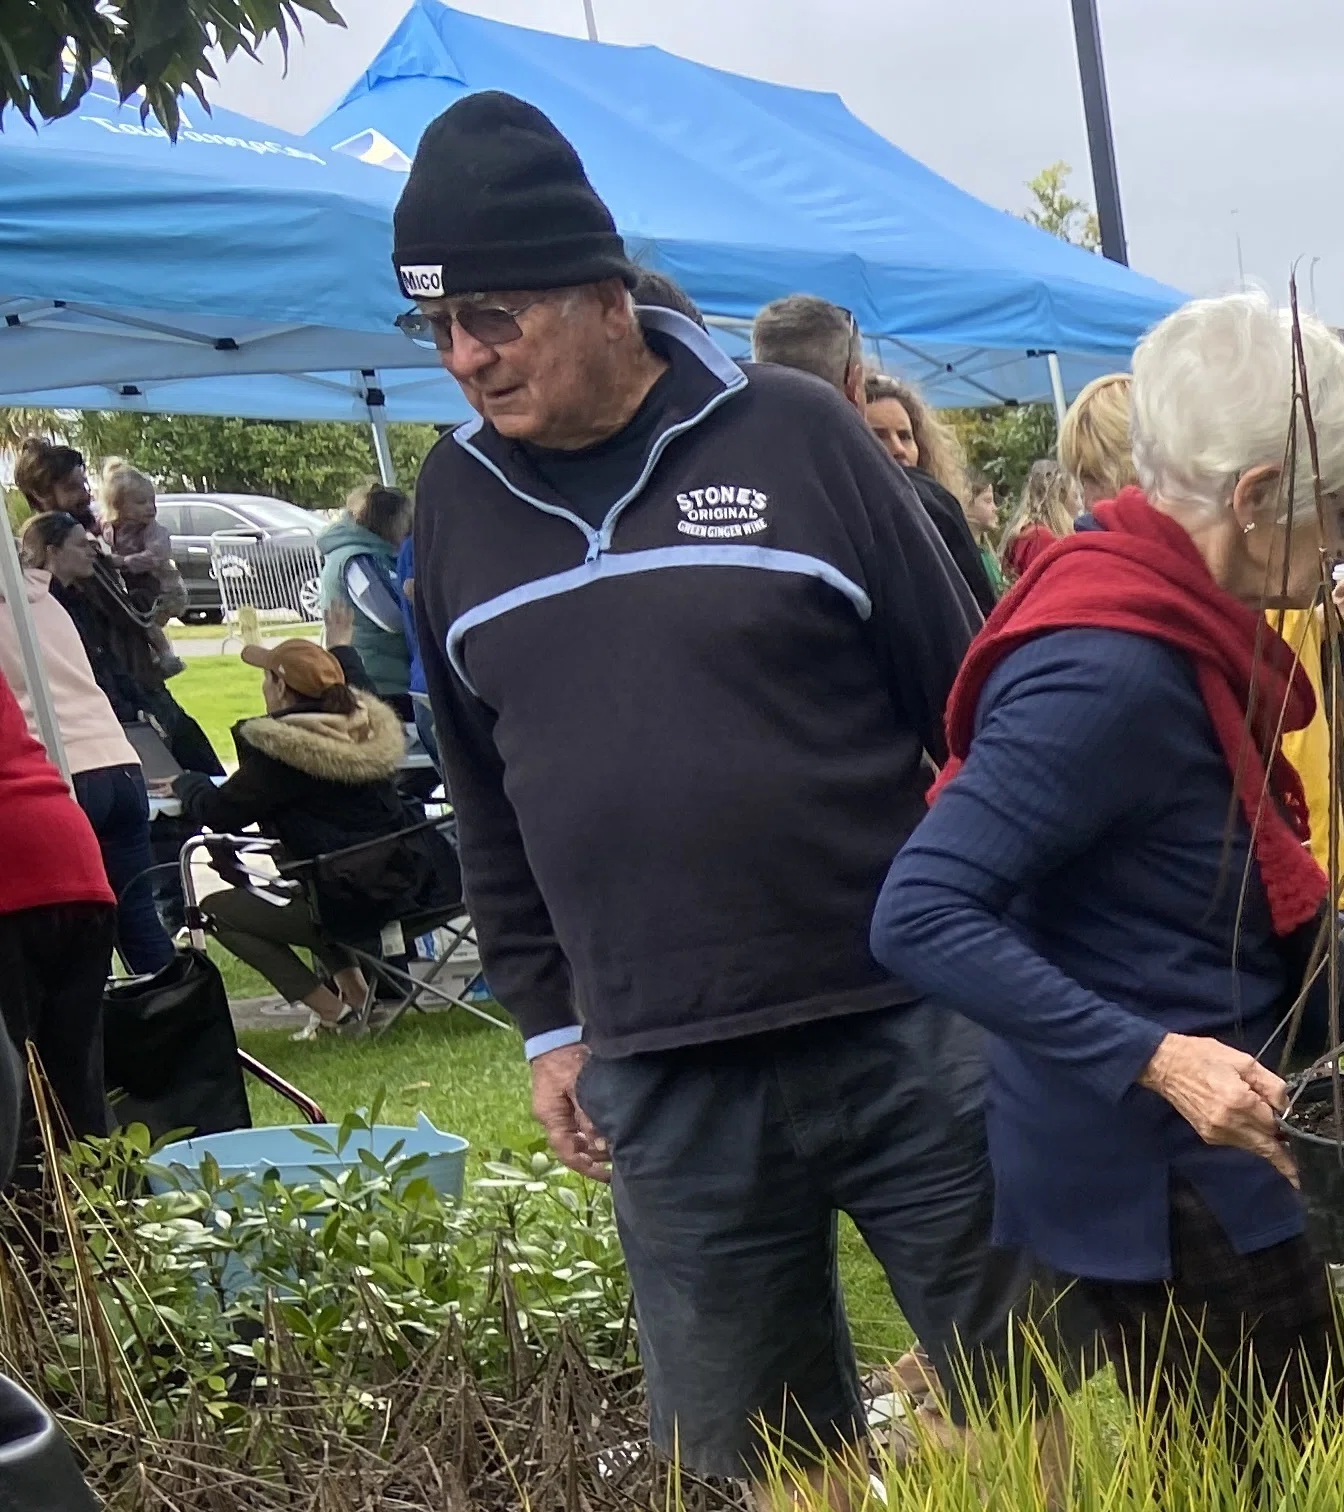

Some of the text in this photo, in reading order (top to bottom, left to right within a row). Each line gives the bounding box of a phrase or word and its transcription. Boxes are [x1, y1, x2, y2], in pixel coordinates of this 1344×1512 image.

[676, 486, 768, 512] STONE'S
[687, 506, 759, 521] ORIGINAL
[677, 517, 768, 538] GREEN GINGER WINE
